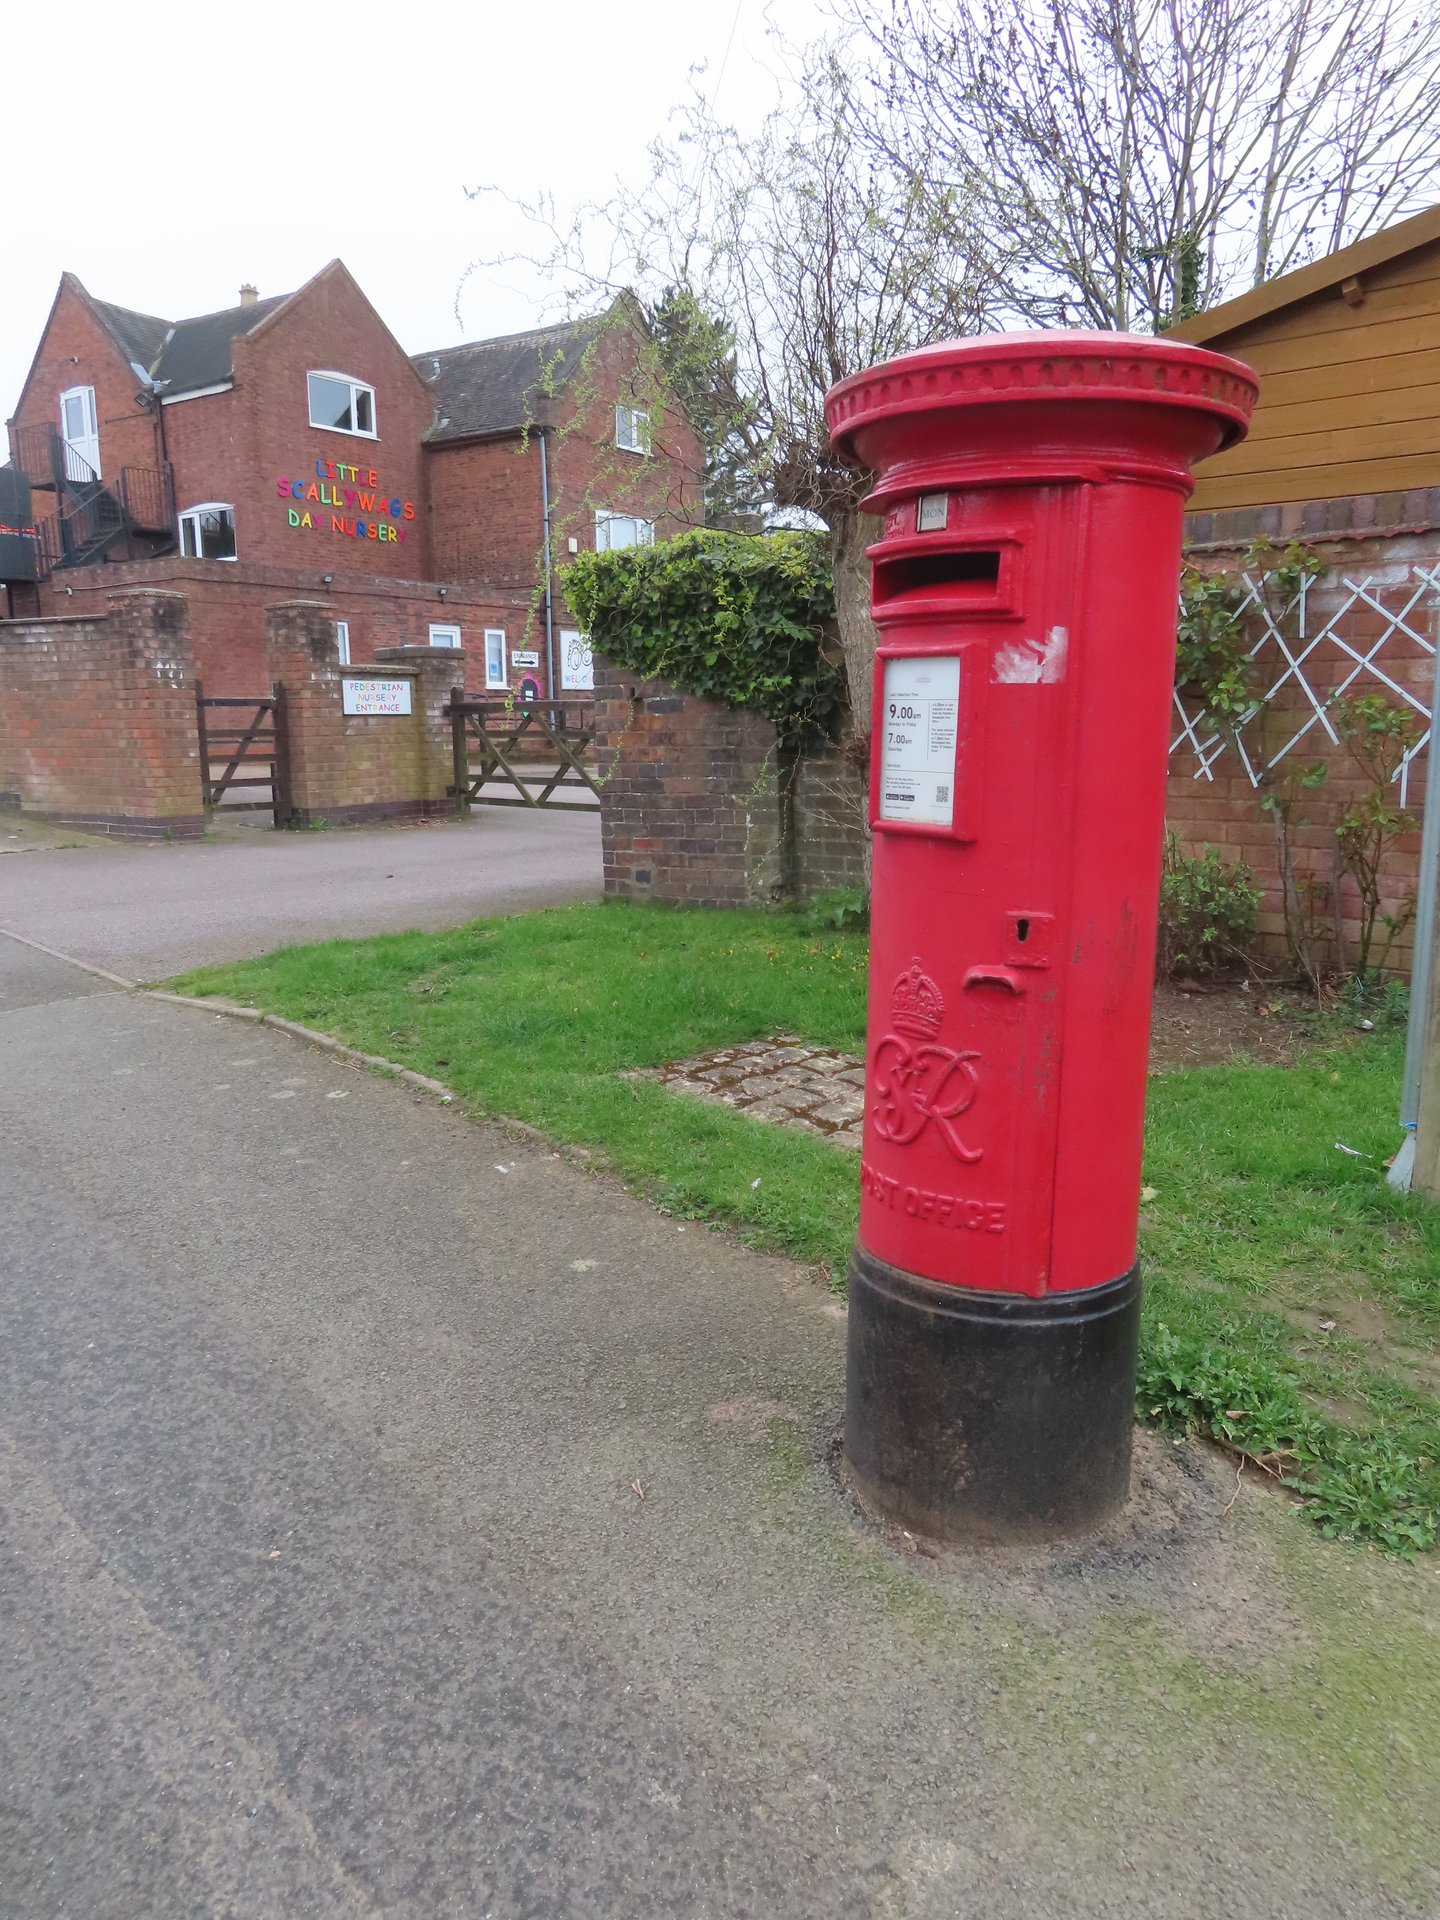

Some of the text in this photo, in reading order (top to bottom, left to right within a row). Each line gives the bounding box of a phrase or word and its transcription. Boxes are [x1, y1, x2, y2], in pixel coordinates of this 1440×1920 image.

[316, 458, 378, 488] LITTLE
[277, 477, 416, 520] SCALLYWAGS
[922, 508, 944, 519] MON
[288, 508, 408, 544] DAY NURSERY
[349, 683, 404, 691] PEDESTRIAN
[355, 703, 400, 712] ENTRANCE
[357, 694, 397, 702] NURSERY
[905, 1187, 1006, 1234] OFFICE
